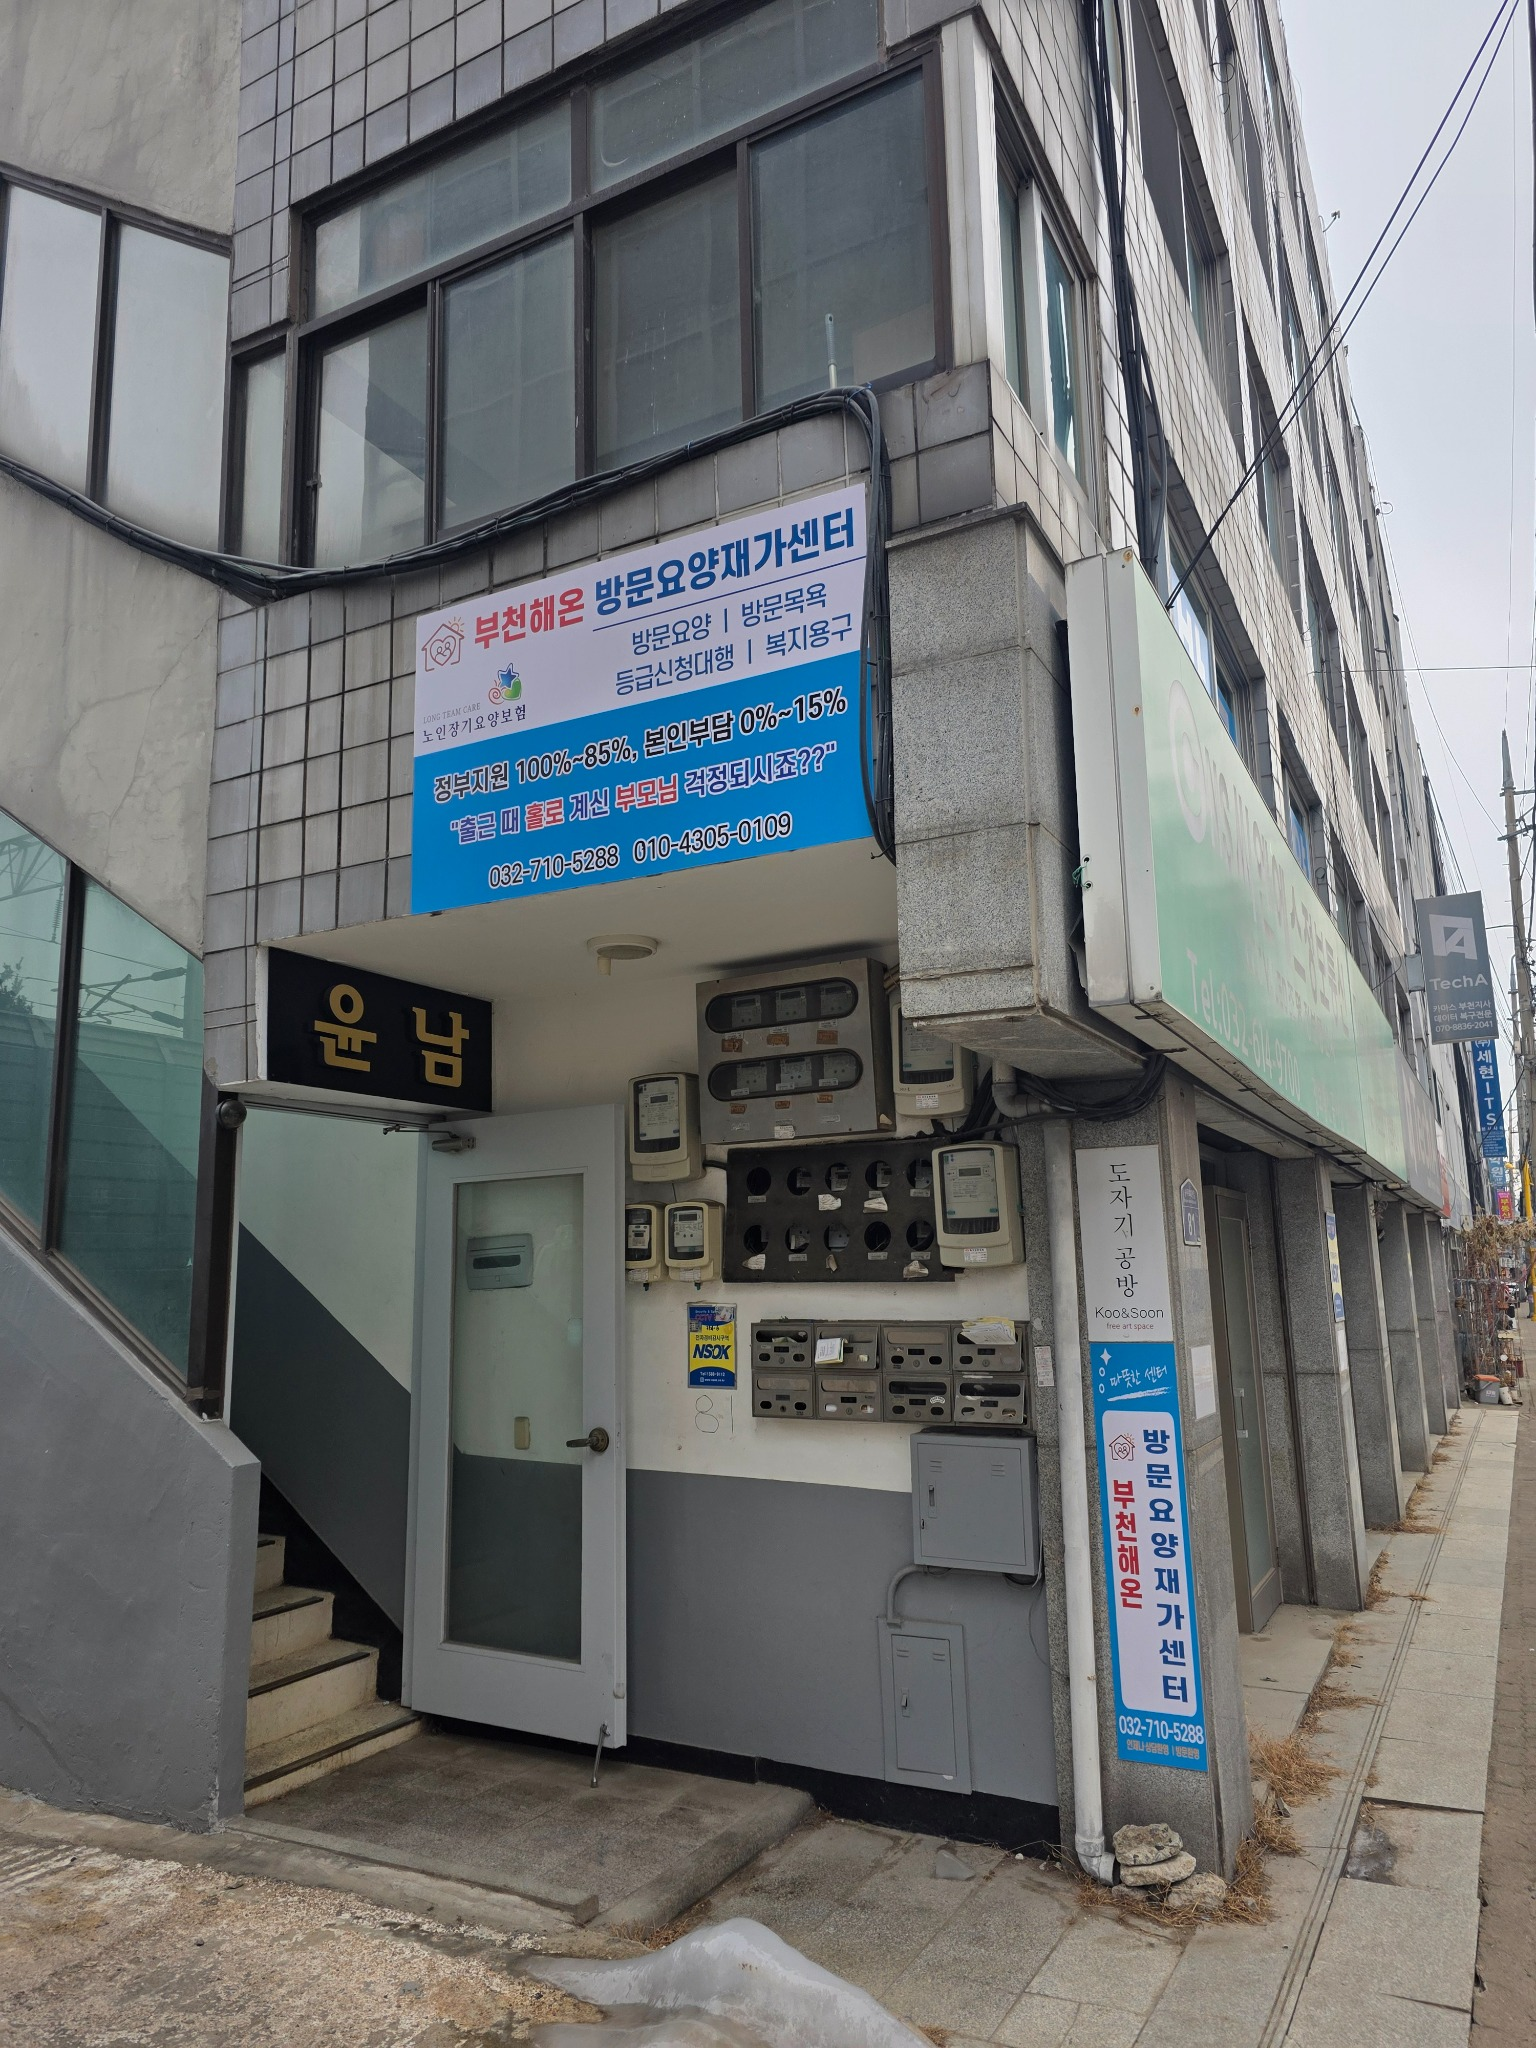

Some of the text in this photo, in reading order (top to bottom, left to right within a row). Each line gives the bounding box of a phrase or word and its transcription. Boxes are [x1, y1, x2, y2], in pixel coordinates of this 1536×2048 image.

[474, 507, 855, 650] 부천해온 방문요양재가센터
[632, 582, 828, 656] 방문요양 방문목욕
[615, 614, 853, 698] 등급신청대행 복지용구
[422, 704, 527, 744] 노인장기요양보험
[423, 702, 481, 724] LONG TEAM CARE
[433, 687, 848, 804] 정부지원 100%~85%, 본인부담 0%~15%
[450, 741, 837, 846] "출근 때 홀로 계신 부모님 걱정되시죠??"
[488, 813, 792, 888] 032-710-5288 010-4305-0109
[1429, 973, 1488, 991] TechA
[1434, 1010, 1493, 1022] 데이터 복구전문
[1459, 1000, 1491, 1010] 부천지사
[1435, 1020, 1493, 1032] 070-8836-2041
[1095, 1307, 1164, 1319] Koo&Soon
[1106, 1322, 1120, 1330] free
[1134, 1322, 1154, 1332] space
[693, 1343, 731, 1359] NSOK
[1145, 1365, 1167, 1384] 센터
[1113, 1478, 1142, 1610] 부천해온
[1142, 1428, 1188, 1703] 방문요양재가센터
[1119, 1715, 1205, 1744] 032-710-5288
